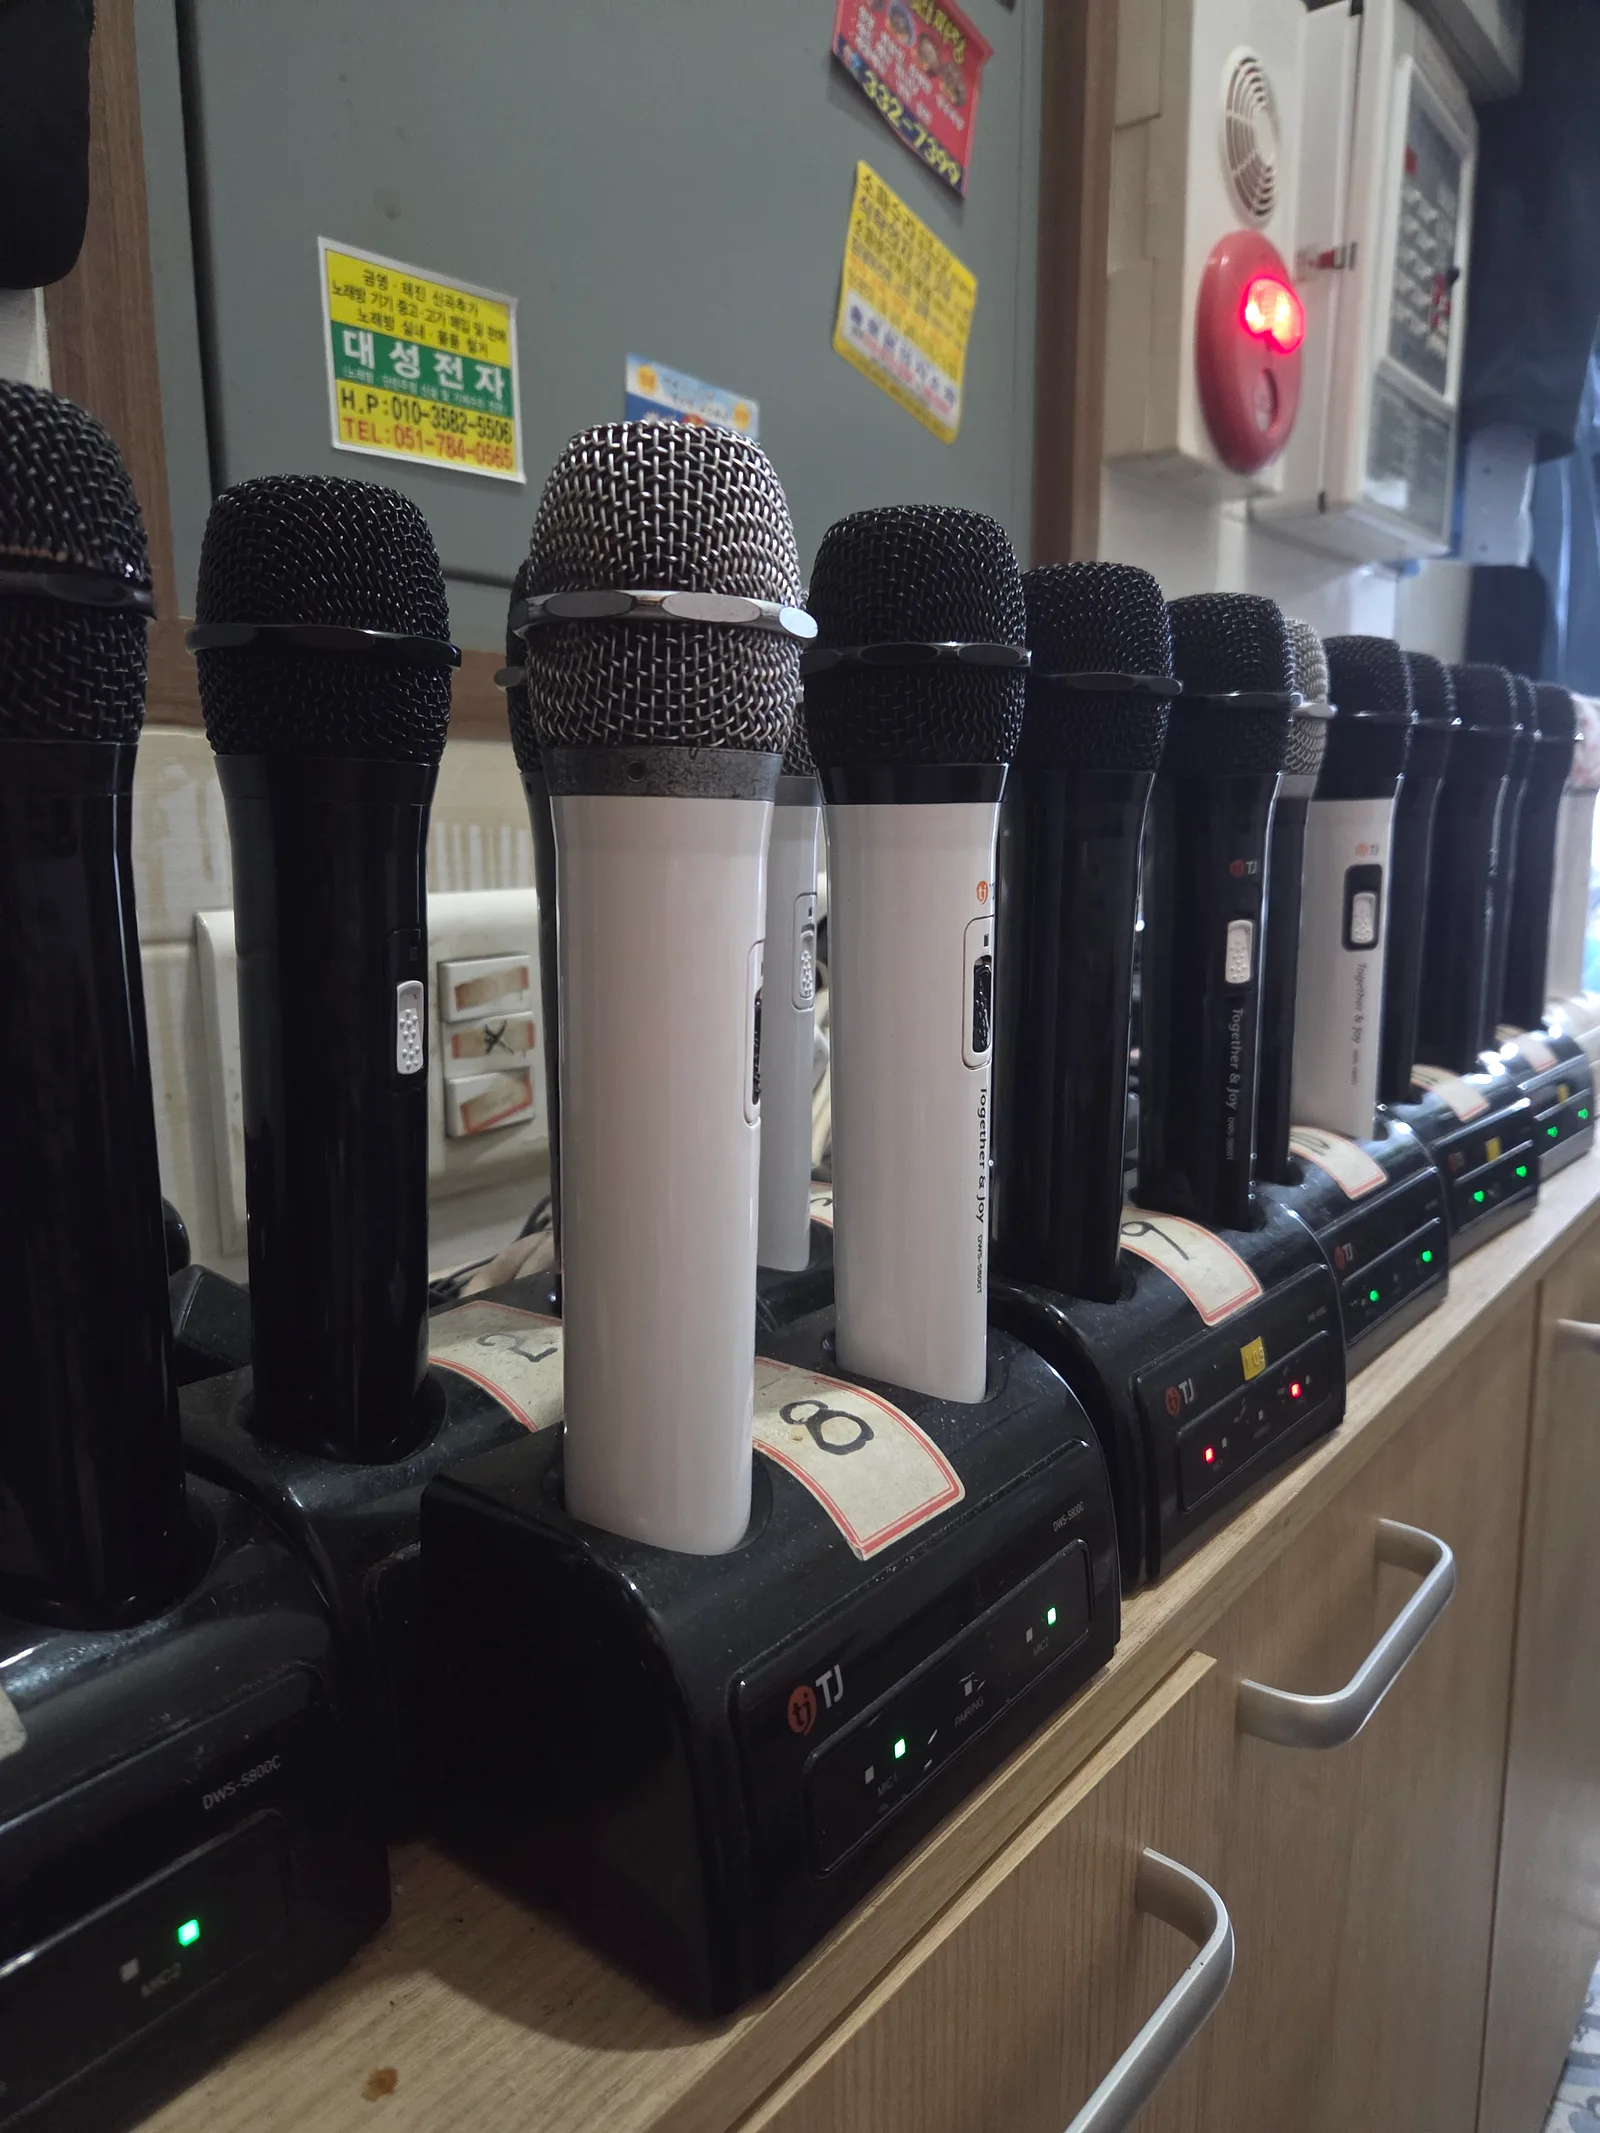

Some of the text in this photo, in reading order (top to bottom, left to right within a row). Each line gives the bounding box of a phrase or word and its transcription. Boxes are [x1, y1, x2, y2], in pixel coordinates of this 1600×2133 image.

[331, 279, 366, 304] 노래방
[357, 306, 395, 332] 노래방
[1229, 1007, 1245, 1070] Together
[1228, 1072, 1241, 1085] &
[1225, 1086, 1240, 1110] Joy
[975, 1194, 986, 1224] Joy
[1178, 1377, 1194, 1404] TJ
[779, 1399, 874, 1456] 8
[815, 1663, 844, 1709] TJ
